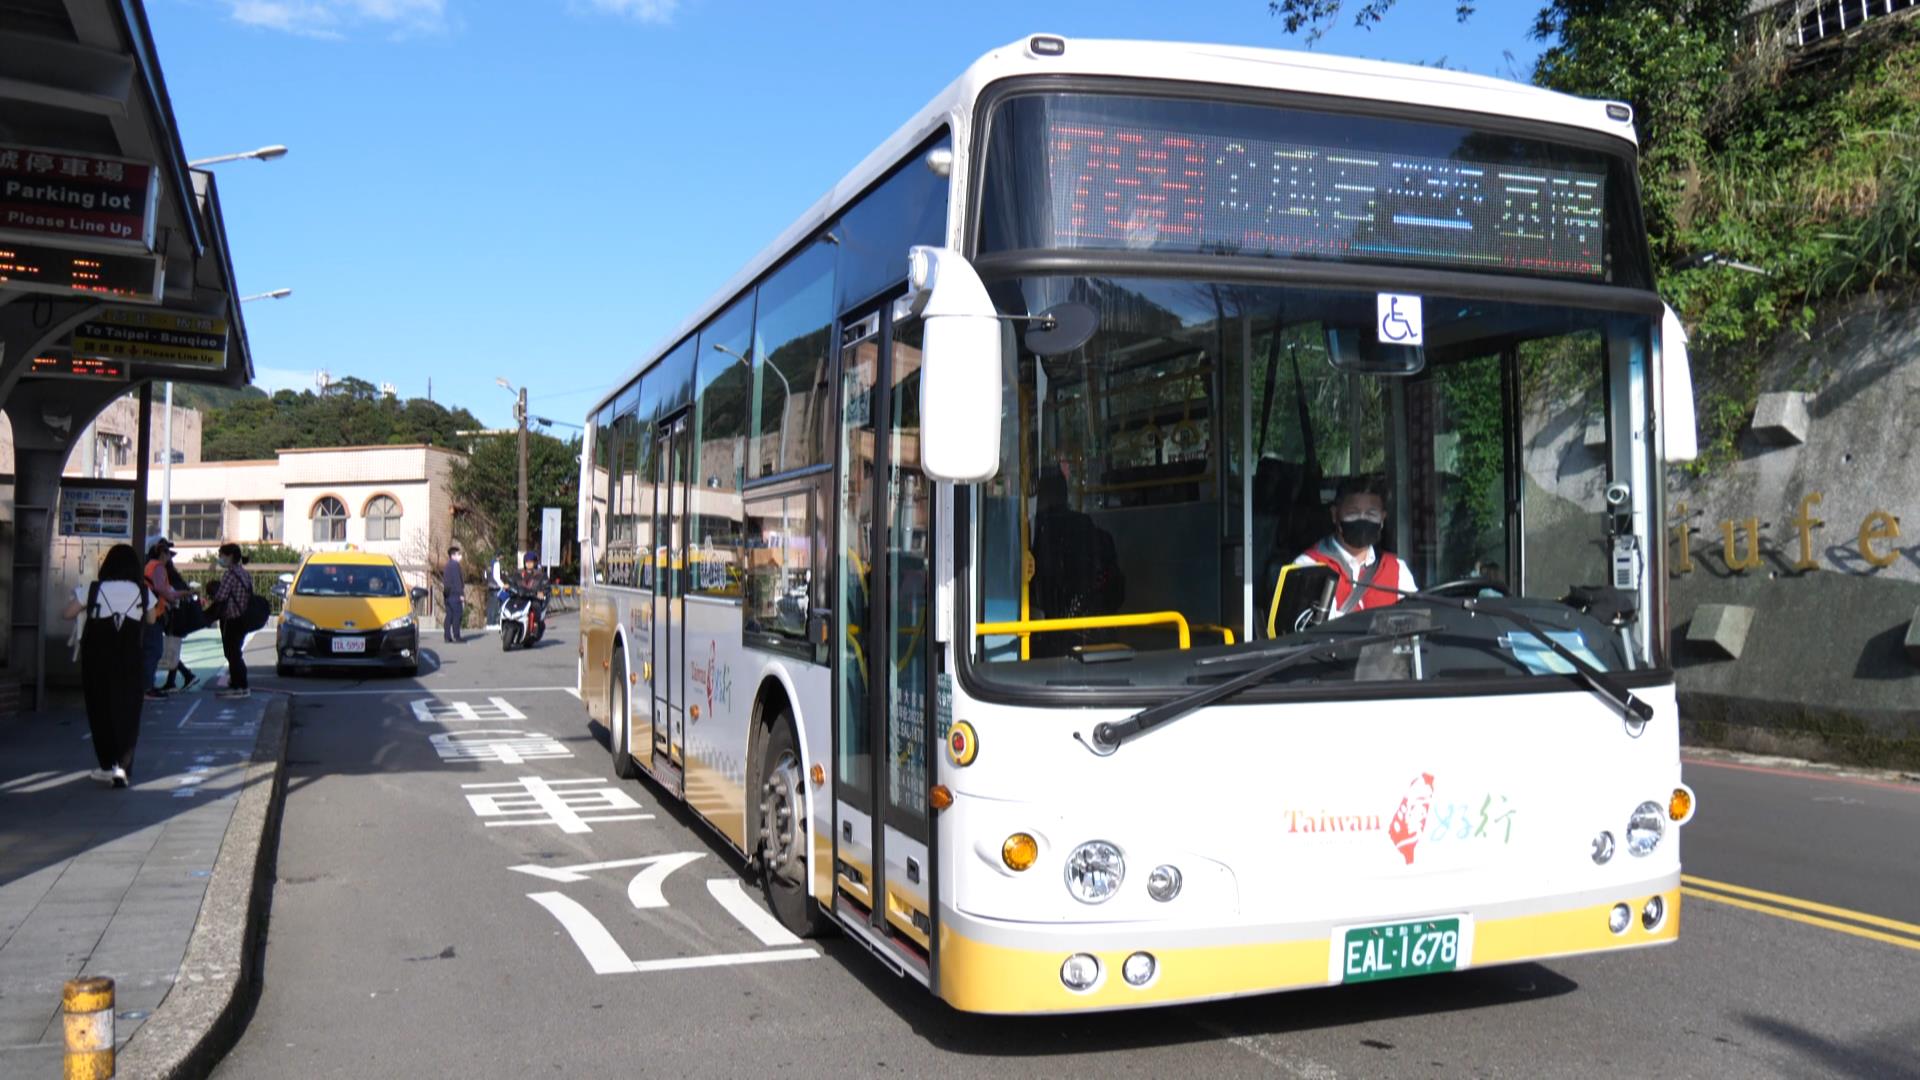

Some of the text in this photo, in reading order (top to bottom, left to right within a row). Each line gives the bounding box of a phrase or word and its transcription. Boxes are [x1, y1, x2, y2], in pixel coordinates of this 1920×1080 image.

[6, 180, 131, 210] Parking lot
[7, 210, 133, 238] Please Line Up
[84, 323, 218, 348] To Taipei Banqiao
[143, 348, 175, 359] Please
[178, 352, 198, 361] Line
[200, 354, 214, 364] Up
[1283, 807, 1382, 834] Taiwan
